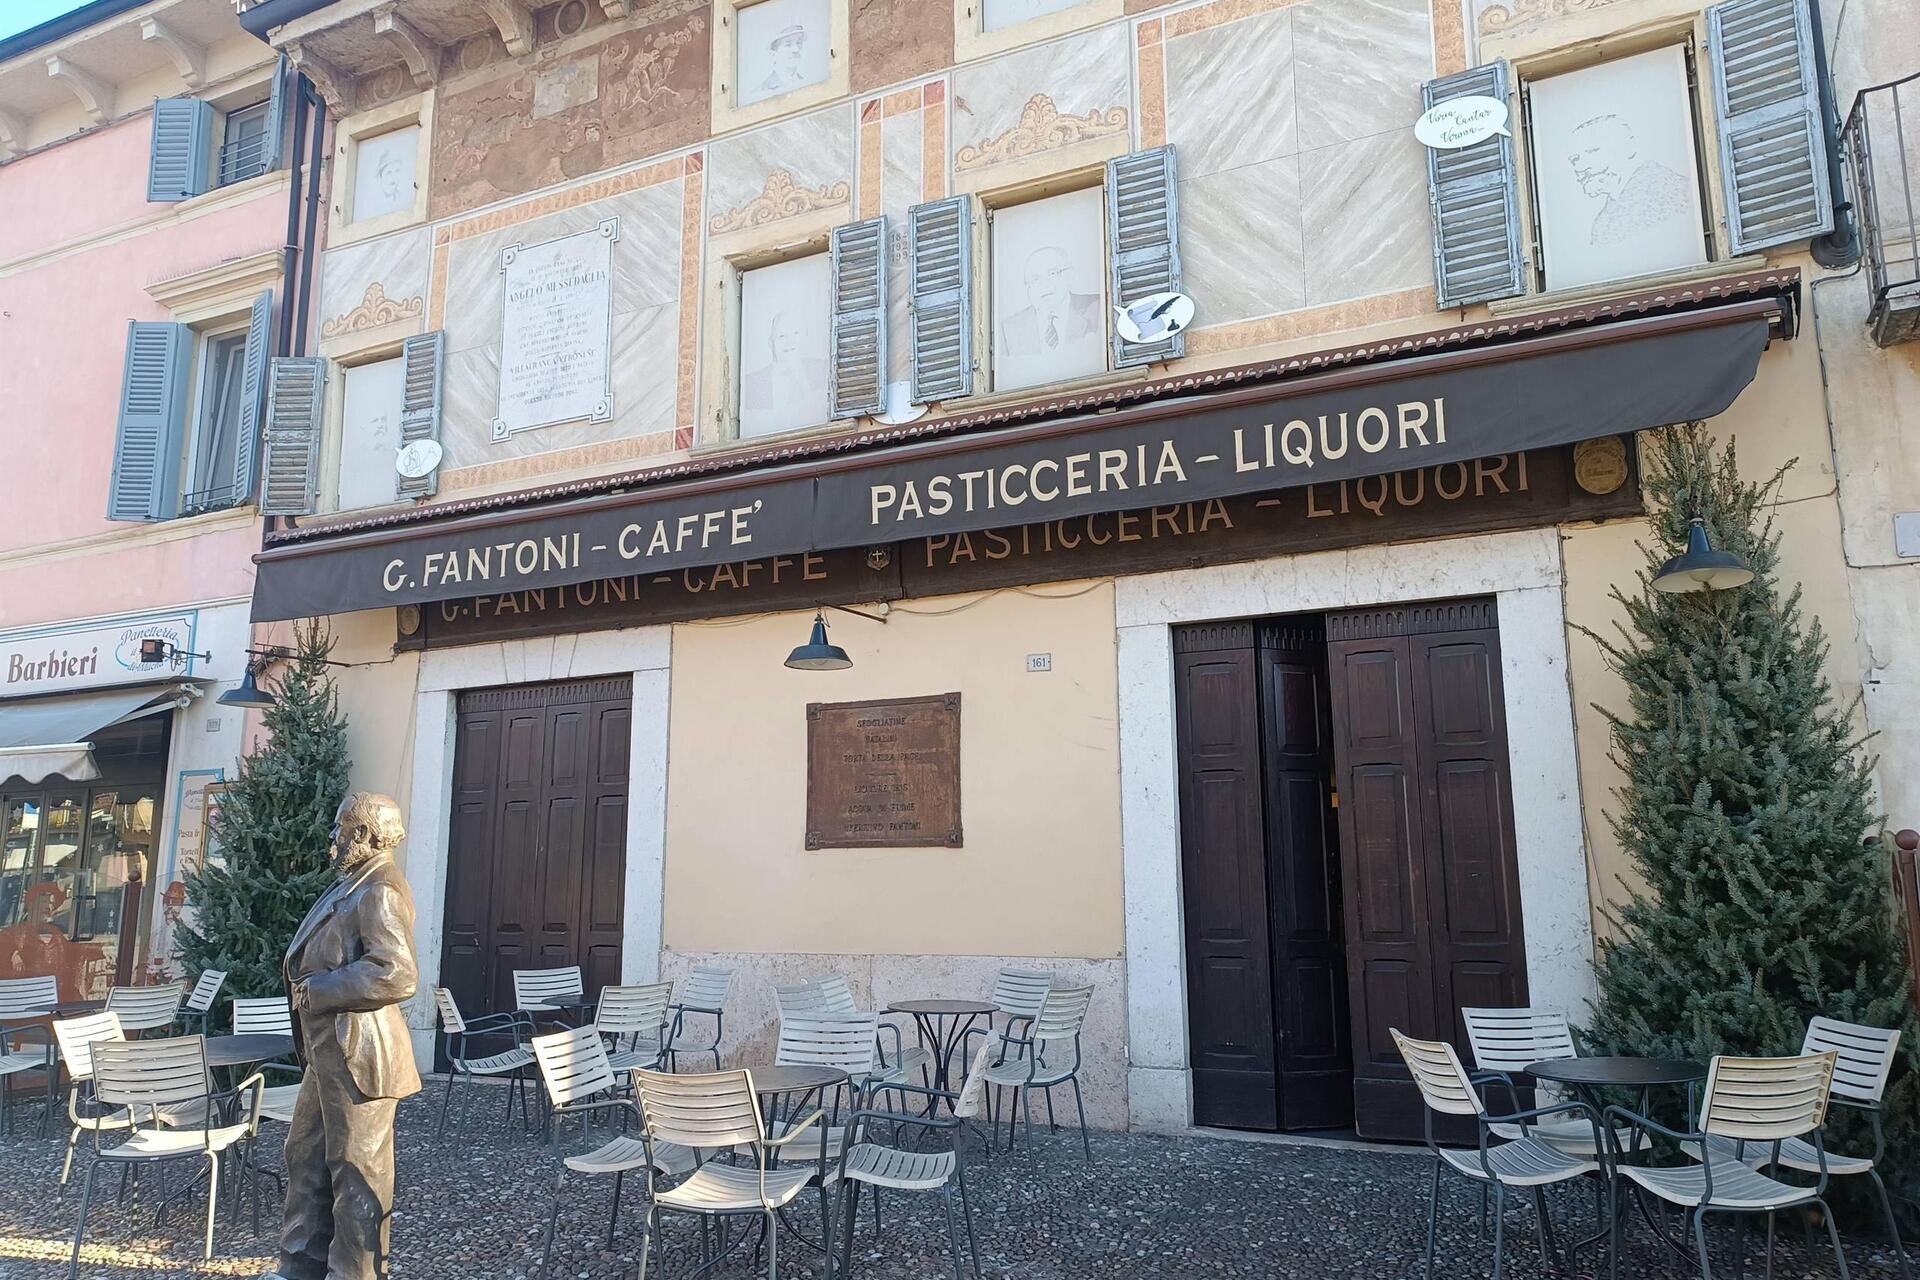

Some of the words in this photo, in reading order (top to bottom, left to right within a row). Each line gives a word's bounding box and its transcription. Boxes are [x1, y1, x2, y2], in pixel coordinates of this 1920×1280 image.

[1455, 109, 1492, 126] Cantar
[510, 286, 543, 303] ANGELO
[546, 271, 606, 292] MESSEDAGLIA
[870, 439, 1188, 525] PASTICCERIA
[1233, 398, 1447, 473] LIQUORI
[926, 498, 1234, 568] PASTICCERIA
[1306, 451, 1529, 518] LIQUORI
[7, 646, 98, 684] Barbieri
[1033, 657, 1046, 668] 161
[856, 717, 907, 729] SFOGLIATINE
[871, 753, 896, 763] DELLA
[889, 821, 921, 832] FANTONI
